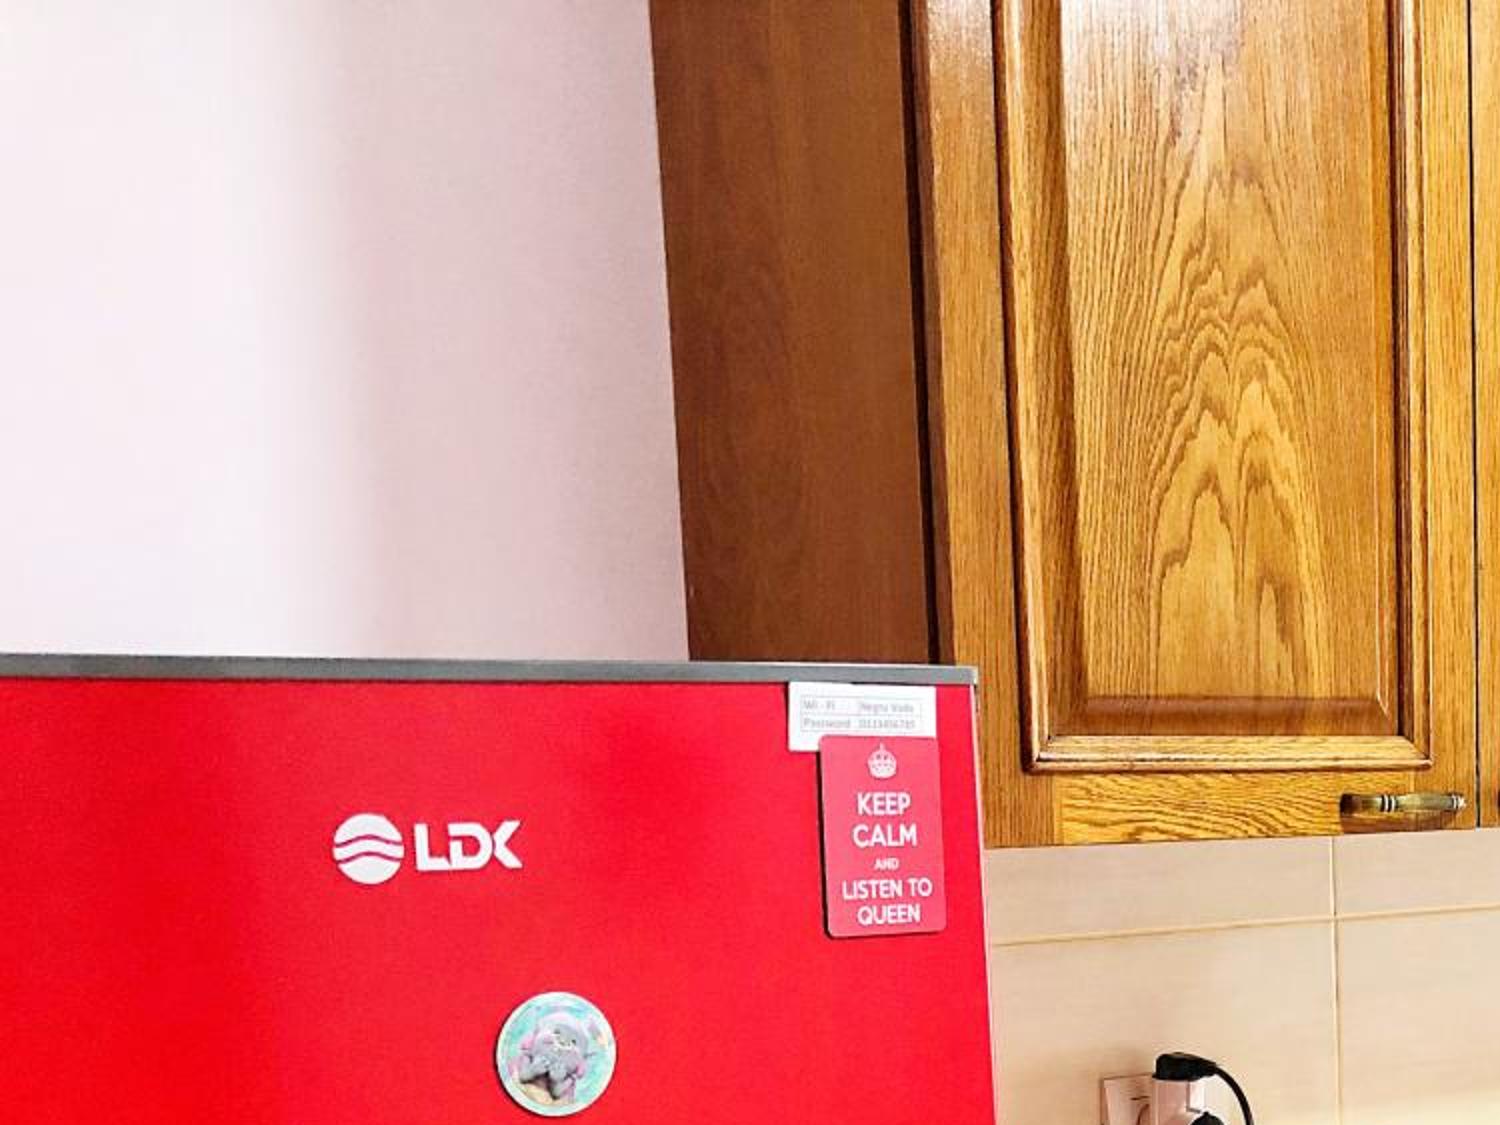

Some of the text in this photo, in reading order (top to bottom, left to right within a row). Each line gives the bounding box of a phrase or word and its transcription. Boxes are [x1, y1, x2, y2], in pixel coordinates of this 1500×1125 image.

[803, 717, 851, 729] Password
[857, 792, 911, 816] KEEP
[852, 823, 917, 848] CALM
[873, 858, 900, 870] AND
[842, 878, 933, 900] LISTEN TO
[857, 904, 921, 925] QUEEN
